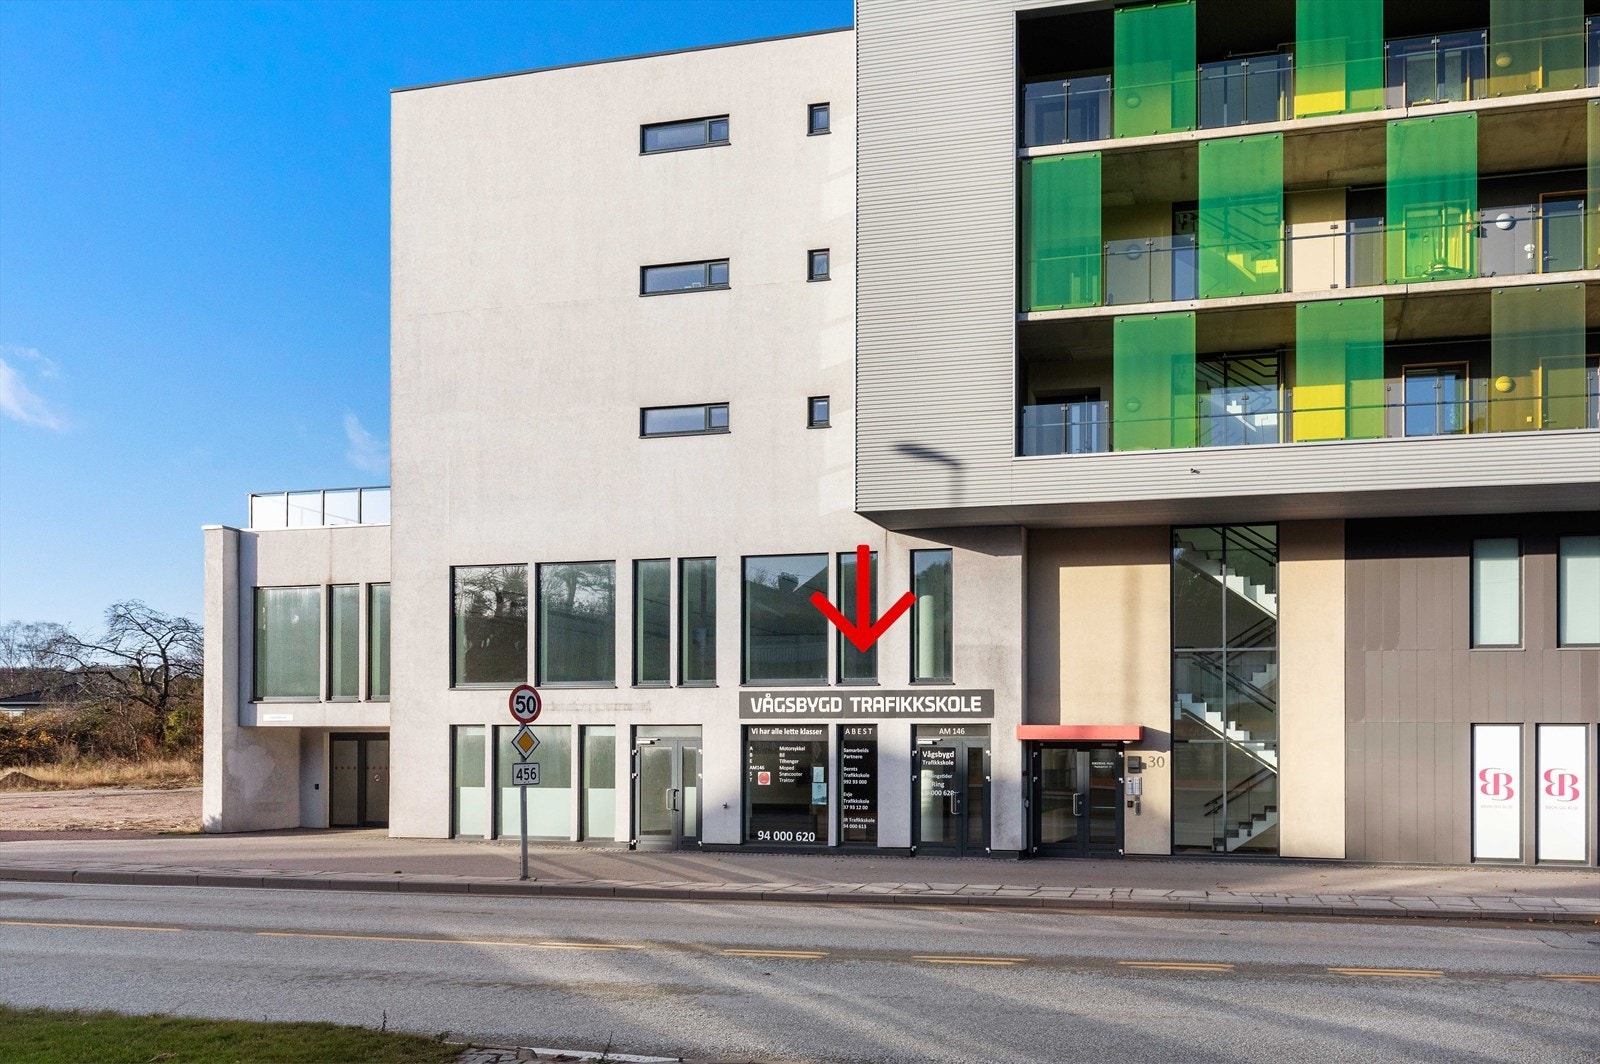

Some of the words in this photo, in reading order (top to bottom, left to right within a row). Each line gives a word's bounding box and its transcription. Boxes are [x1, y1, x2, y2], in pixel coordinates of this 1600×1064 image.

[516, 695, 536, 714] 50
[750, 693, 842, 713] VÅGSBYGD
[850, 696, 982, 712] TRAFIKKSKOLE
[922, 750, 955, 759] Vågsbygd
[1148, 756, 1165, 768] 30
[516, 767, 537, 780] 456
[758, 830, 771, 840] 94
[773, 831, 793, 841] 000
[796, 832, 816, 842] 620
